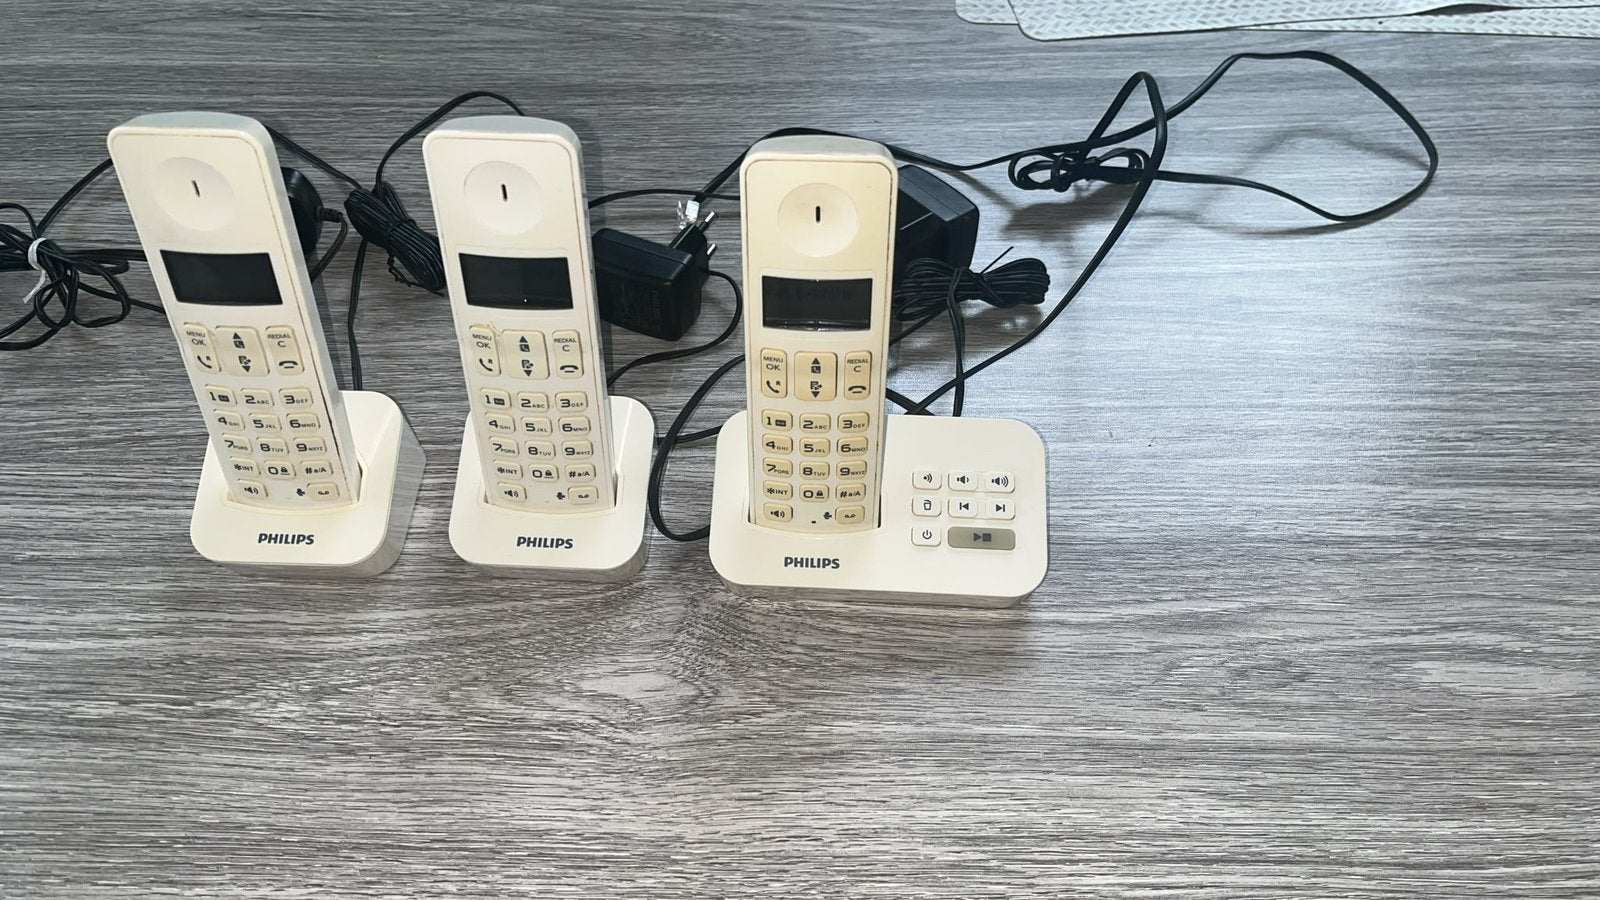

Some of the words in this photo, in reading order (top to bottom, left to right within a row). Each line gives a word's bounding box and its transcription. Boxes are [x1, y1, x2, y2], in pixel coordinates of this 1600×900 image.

[191, 338, 207, 346] OK
[476, 341, 491, 349] OK
[766, 363, 781, 371] OK
[257, 533, 314, 545] PHILIPS
[516, 536, 573, 549] PHILIPS
[784, 556, 840, 569] PHILIPS
